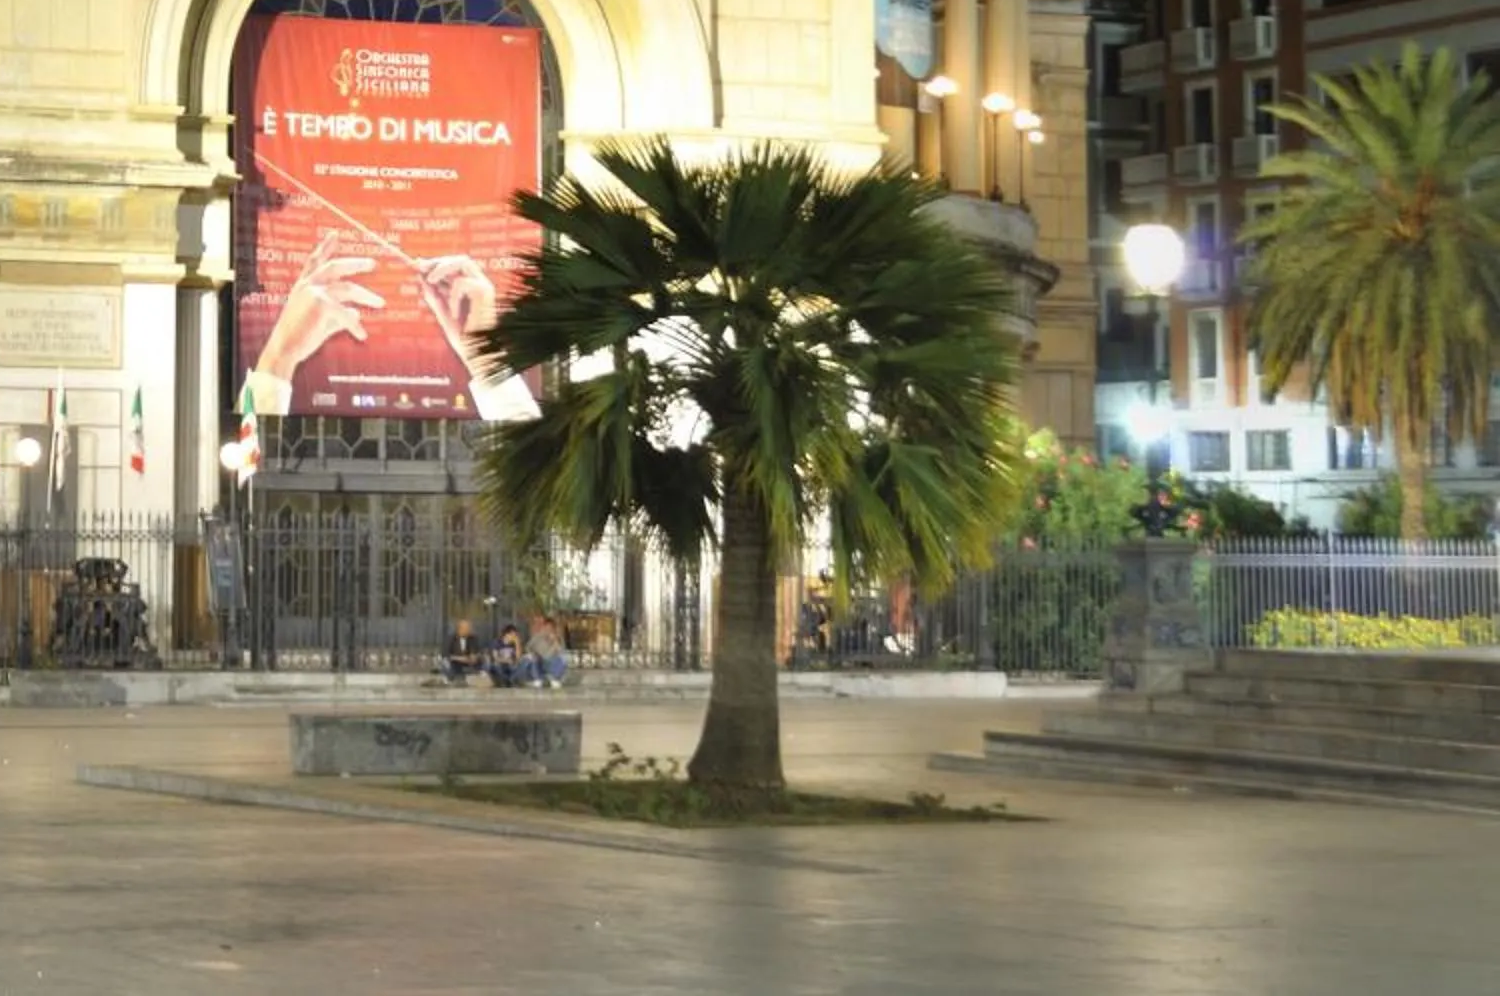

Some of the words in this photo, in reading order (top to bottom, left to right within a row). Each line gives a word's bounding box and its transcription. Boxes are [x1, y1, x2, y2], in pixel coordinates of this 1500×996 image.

[356, 49, 430, 65] ORCHESTRA
[355, 64, 430, 79] SINFONICA
[355, 77, 430, 92] SICILIANA
[263, 106, 277, 135] È
[285, 111, 372, 142] TEMPO
[380, 116, 407, 141] DI
[414, 119, 512, 146] MUSICA
